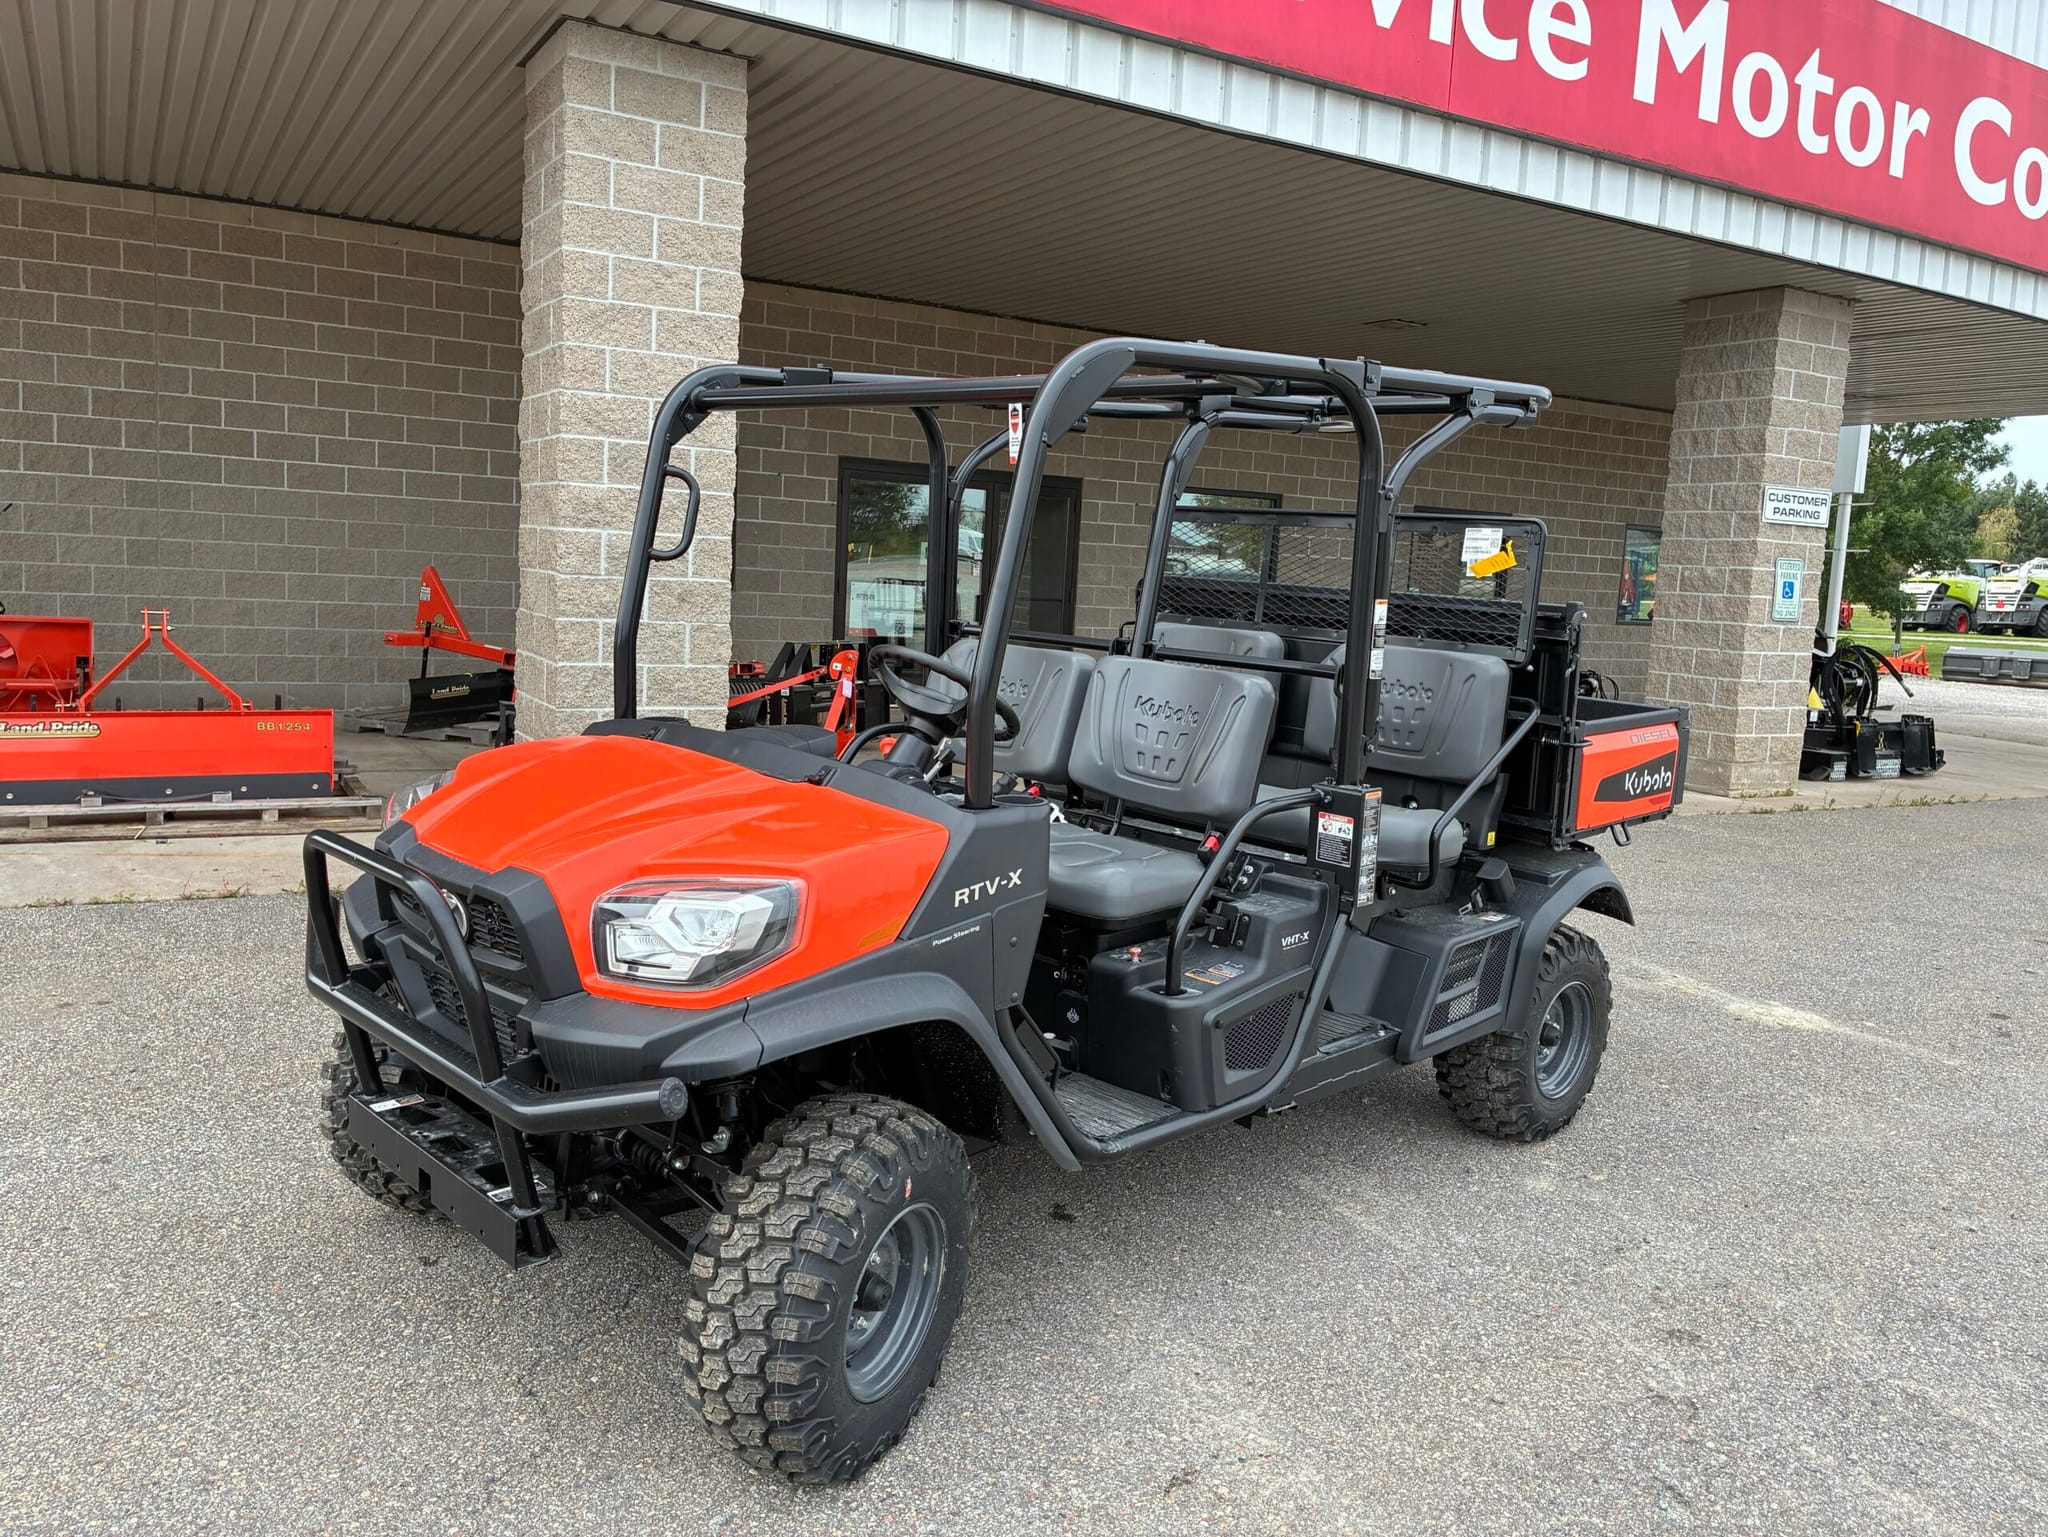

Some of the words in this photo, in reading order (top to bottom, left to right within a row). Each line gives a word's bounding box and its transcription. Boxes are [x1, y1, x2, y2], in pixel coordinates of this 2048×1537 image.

[1633, 0, 1931, 179] Motor
[1954, 96, 2048, 220] Co
[1768, 492, 1828, 508] CUSTOMER
[1772, 506, 1821, 520] PARKING
[1381, 678, 1433, 703] ubota
[1134, 695, 1200, 727] Kubota
[0, 721, 46, 735] Land
[50, 721, 99, 736] Pride
[257, 722, 311, 731] BB1254
[1630, 728, 1677, 744] DIESEL
[1624, 765, 1672, 796] Kubota
[954, 868, 1023, 908] RTV-X
[932, 935, 953, 947] Power
[1281, 930, 1310, 946] VHT-X
